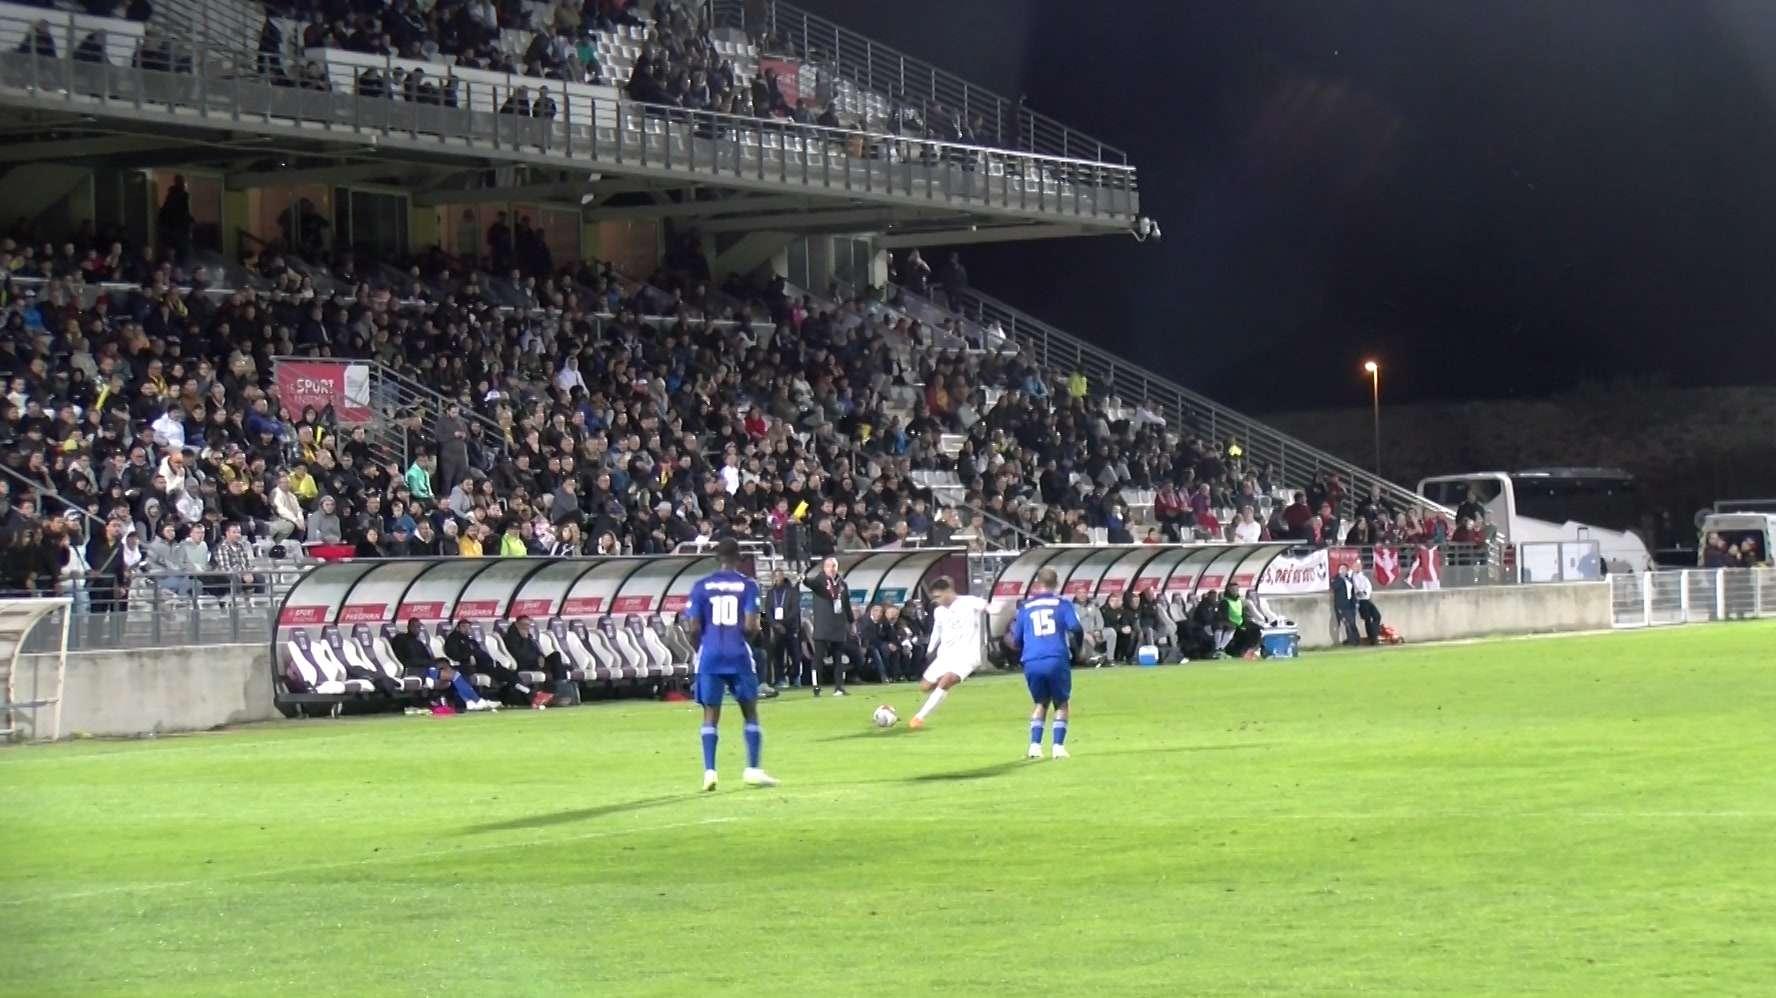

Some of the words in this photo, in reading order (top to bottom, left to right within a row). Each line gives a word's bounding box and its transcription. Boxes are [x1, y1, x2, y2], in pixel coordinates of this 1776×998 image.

[296, 379, 335, 395] SPORT
[709, 595, 738, 626] 10
[1030, 608, 1056, 637] 15
